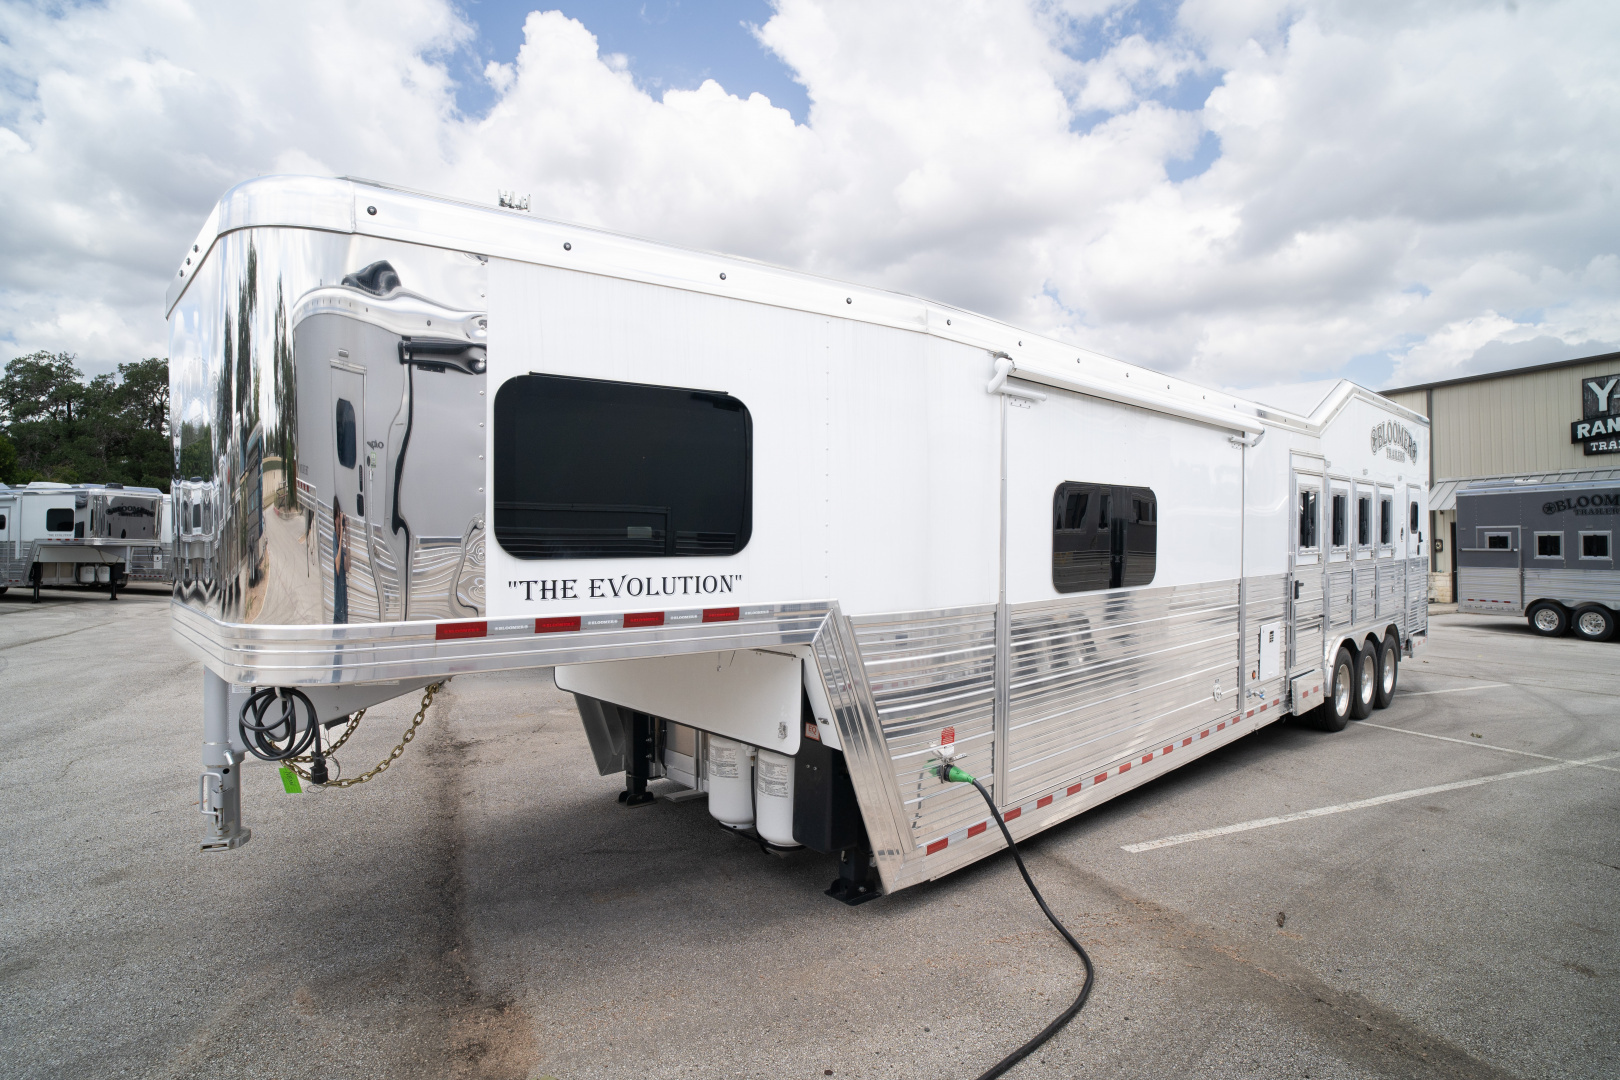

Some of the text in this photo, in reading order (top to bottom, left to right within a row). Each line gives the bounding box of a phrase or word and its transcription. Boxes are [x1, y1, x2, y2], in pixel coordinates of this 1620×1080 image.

[1376, 419, 1413, 460] BLOOMER
[1590, 440, 1620, 451] TRA
[508, 574, 743, 601] "THE EVOLUTION"
